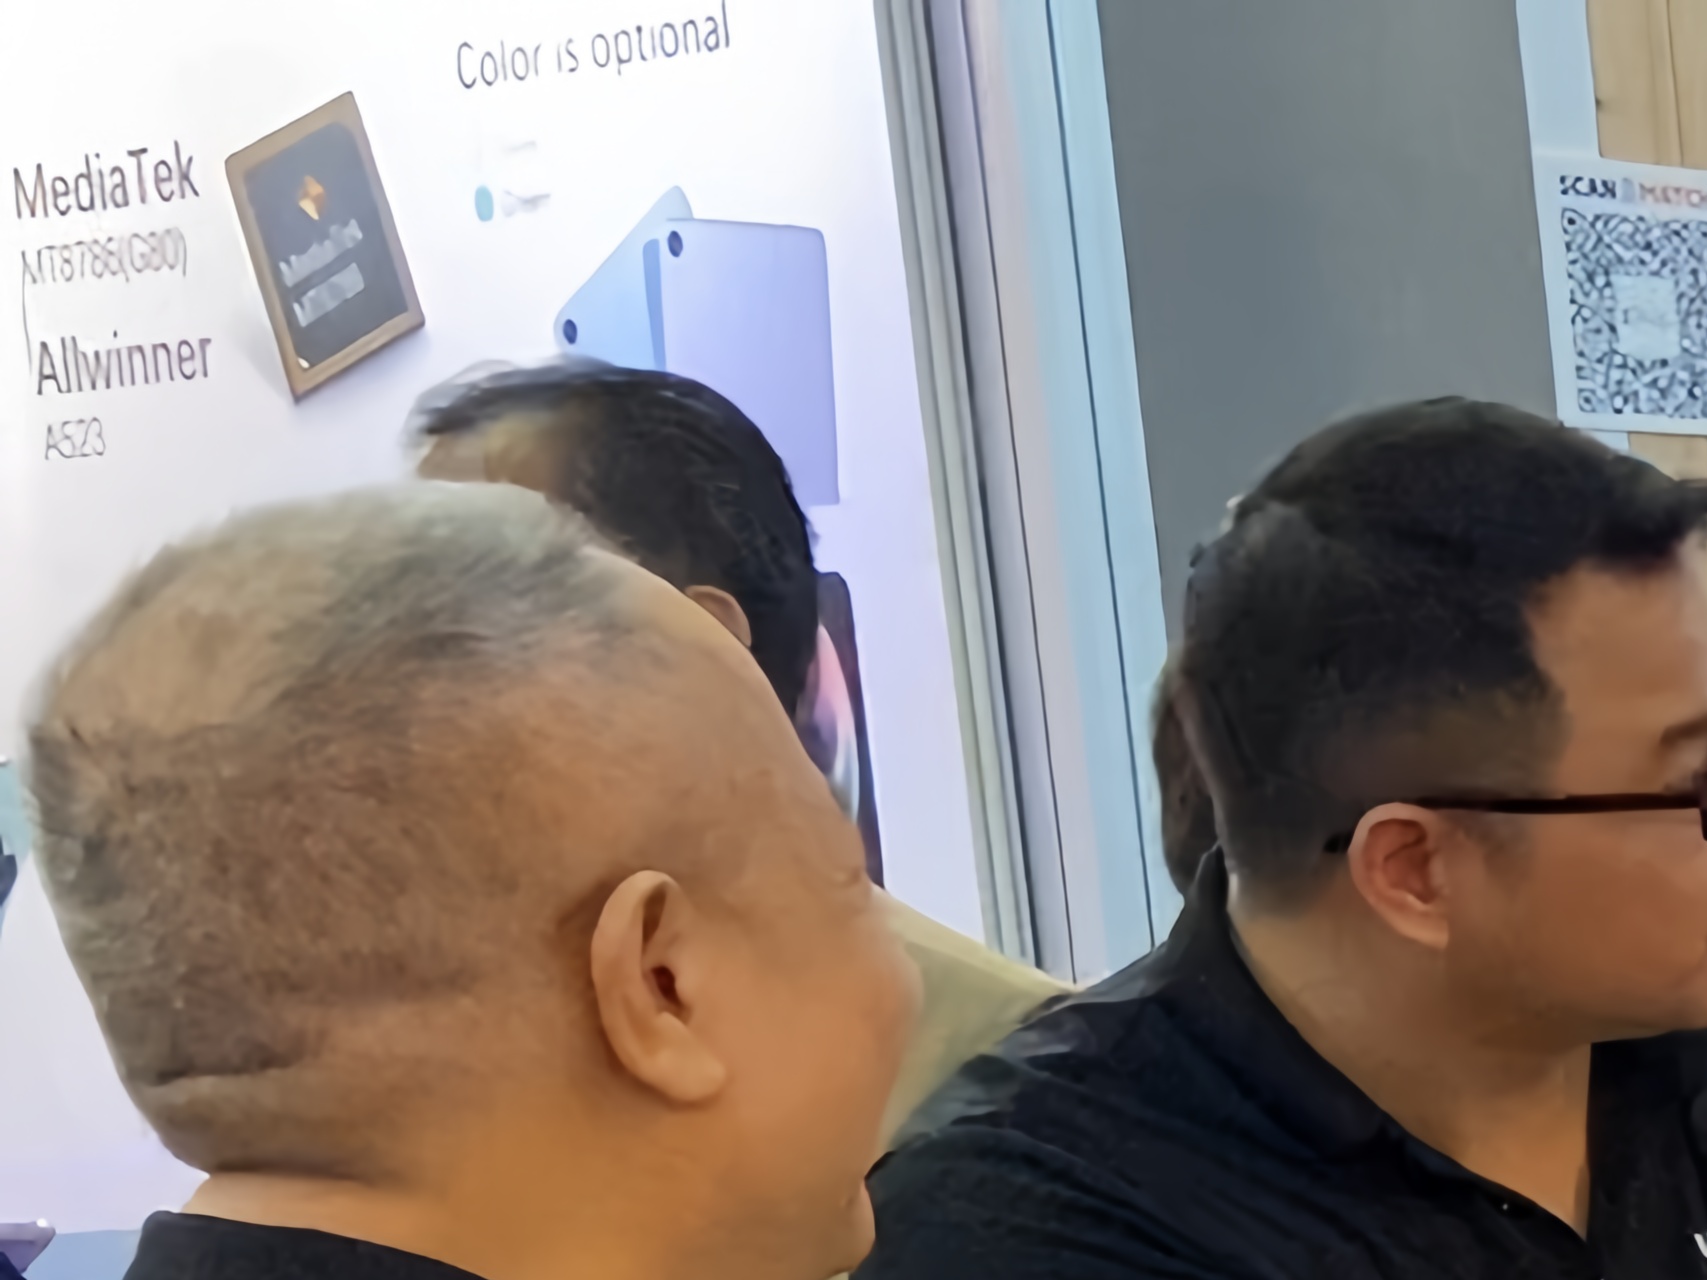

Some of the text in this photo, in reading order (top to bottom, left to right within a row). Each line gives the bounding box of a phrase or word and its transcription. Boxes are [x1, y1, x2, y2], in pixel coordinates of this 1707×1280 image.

[456, 0, 730, 89] Color is optional
[13, 139, 200, 219] MediaTek
[36, 329, 212, 396] Allwinner
